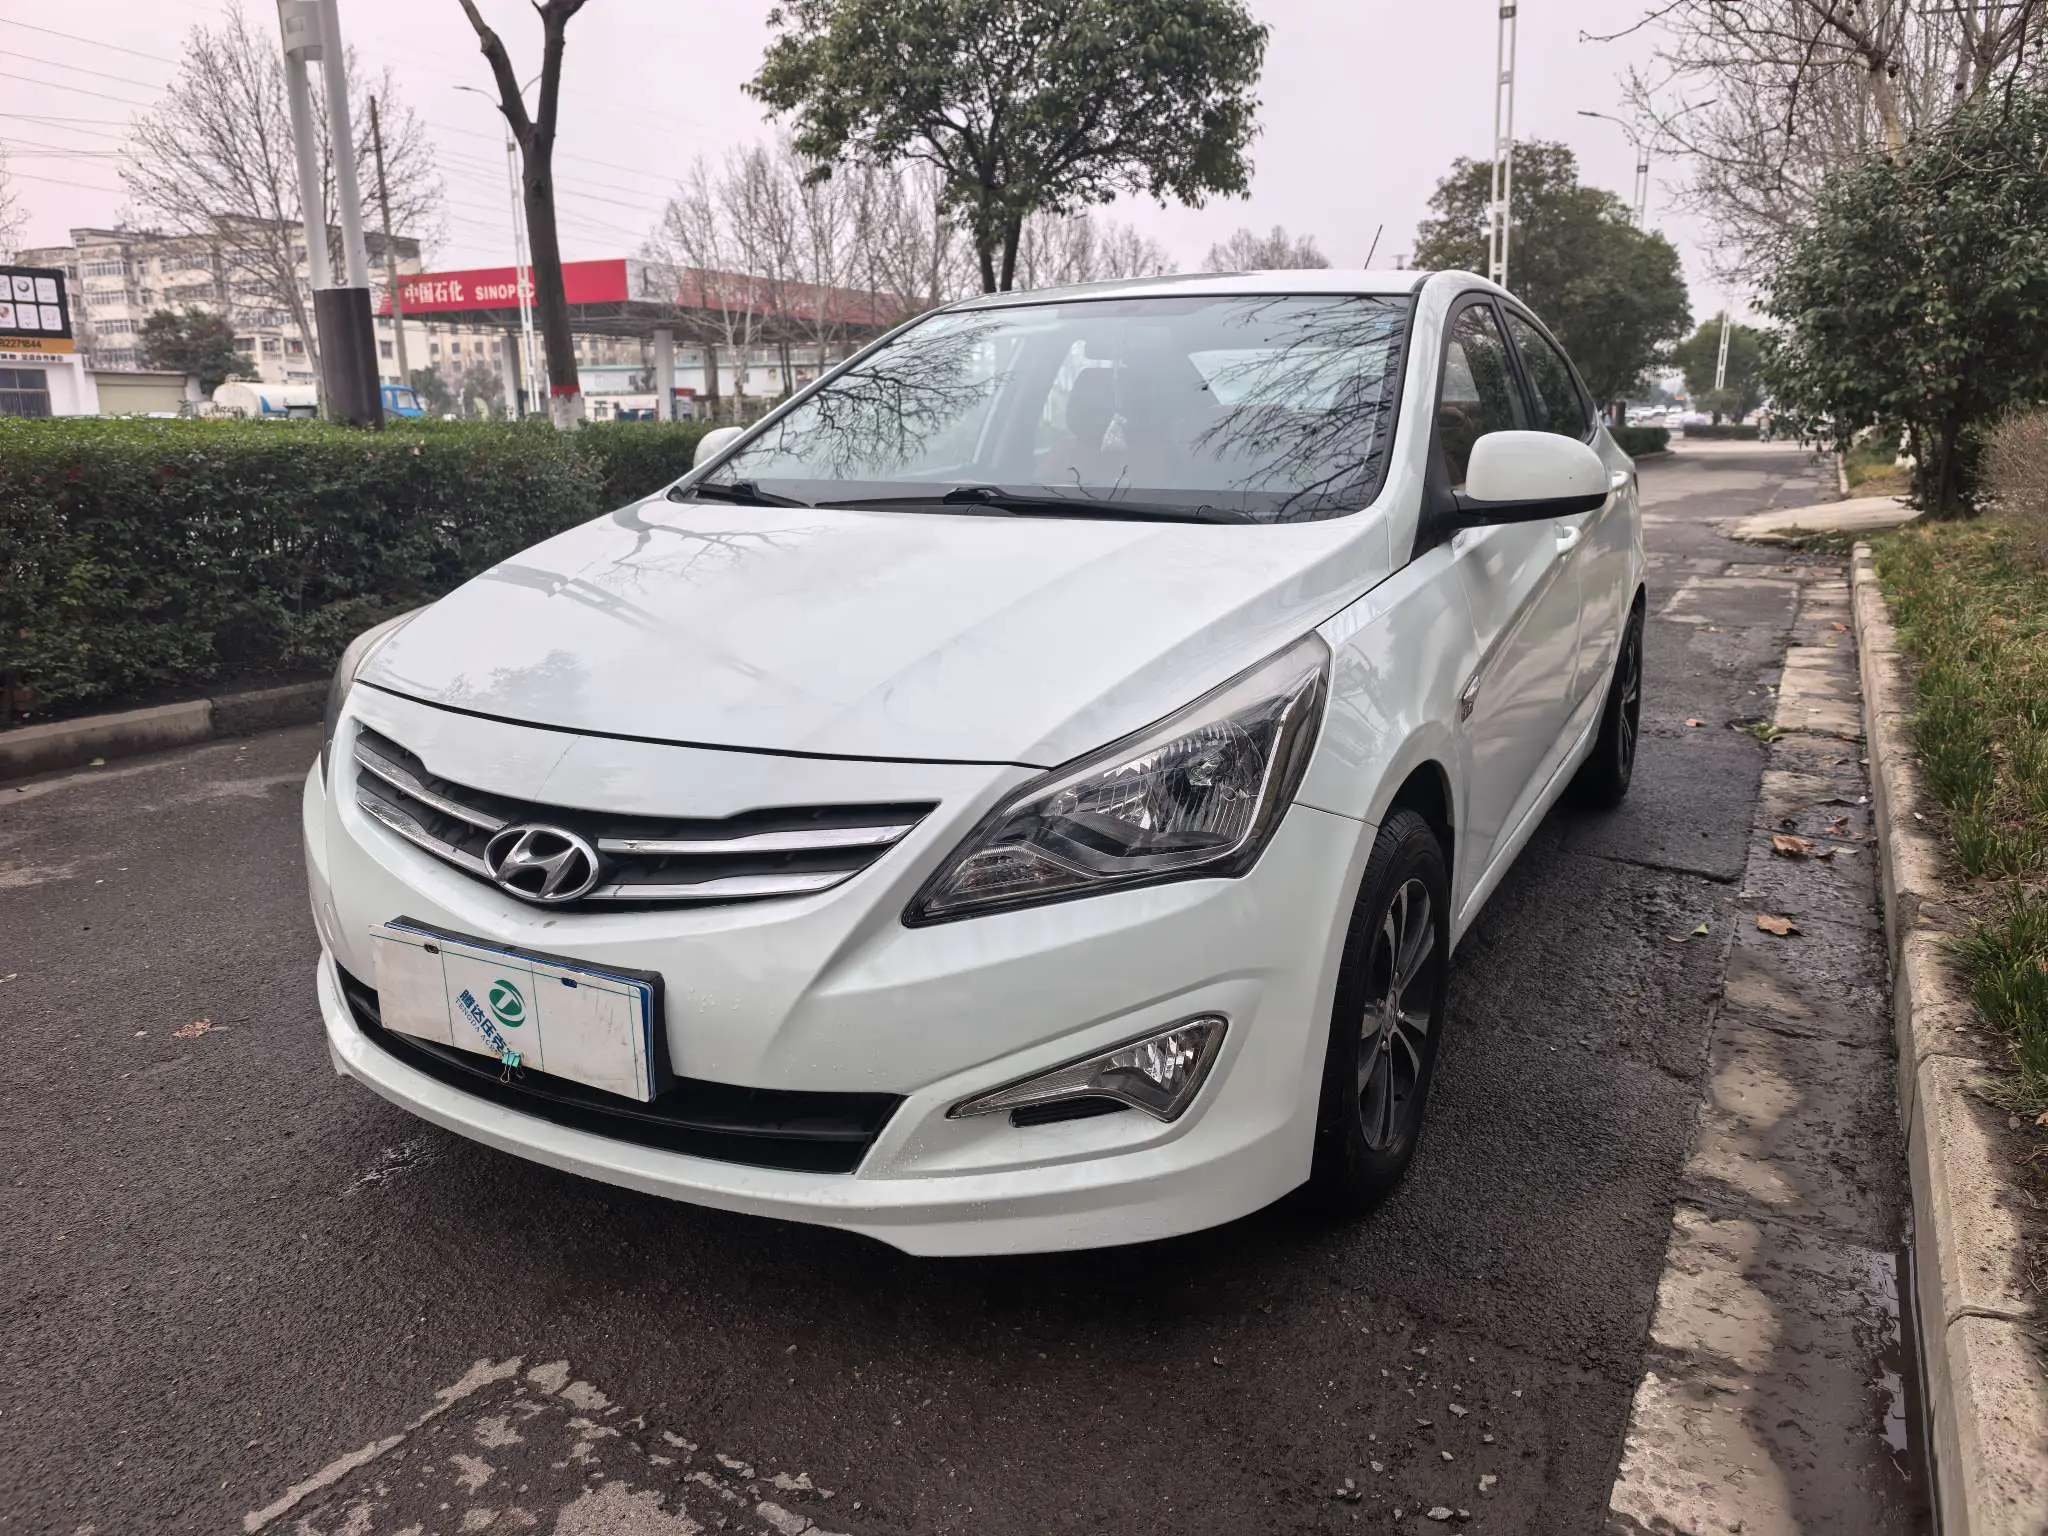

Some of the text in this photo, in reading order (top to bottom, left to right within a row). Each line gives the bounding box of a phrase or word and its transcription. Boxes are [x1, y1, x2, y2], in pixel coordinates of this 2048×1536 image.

[404, 280, 464, 304] 中国石化
[456, 996, 480, 1033] TENGDA
[459, 989, 512, 1055] 腾达压克
